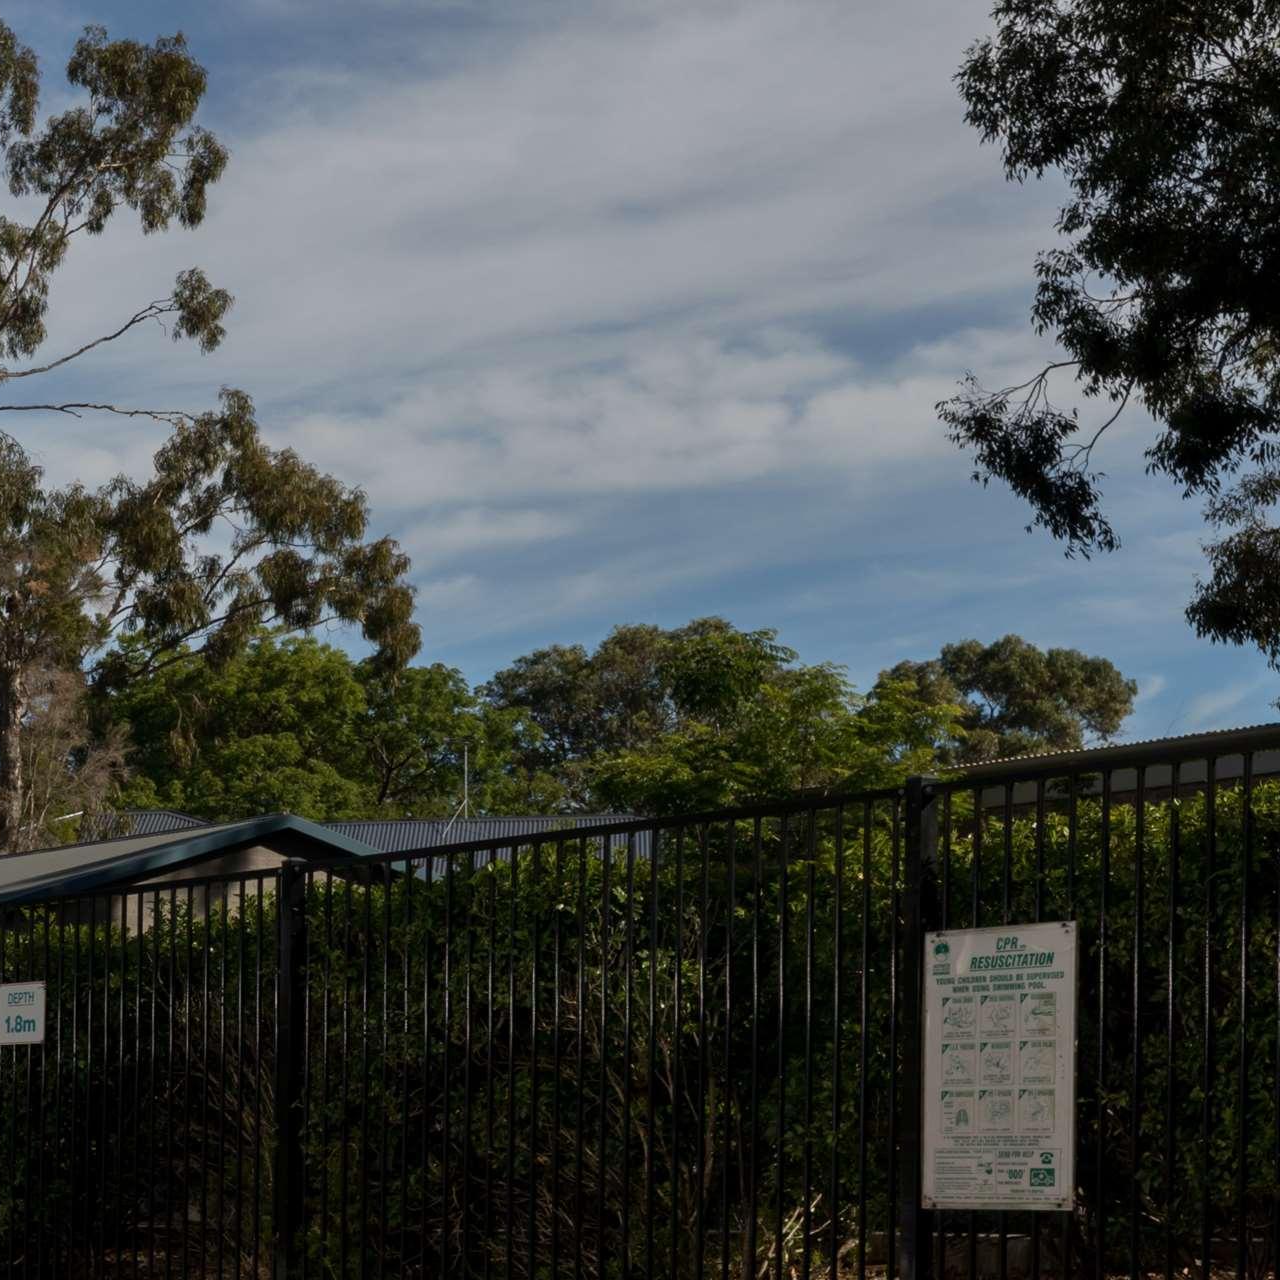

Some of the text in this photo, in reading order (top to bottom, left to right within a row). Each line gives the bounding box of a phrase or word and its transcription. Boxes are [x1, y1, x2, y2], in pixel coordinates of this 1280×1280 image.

[996, 937, 1018, 950] CPR
[970, 952, 1055, 970] RESUSCITATION
[8, 991, 35, 1003] DEPTH
[5, 1014, 36, 1033] 1.8m
